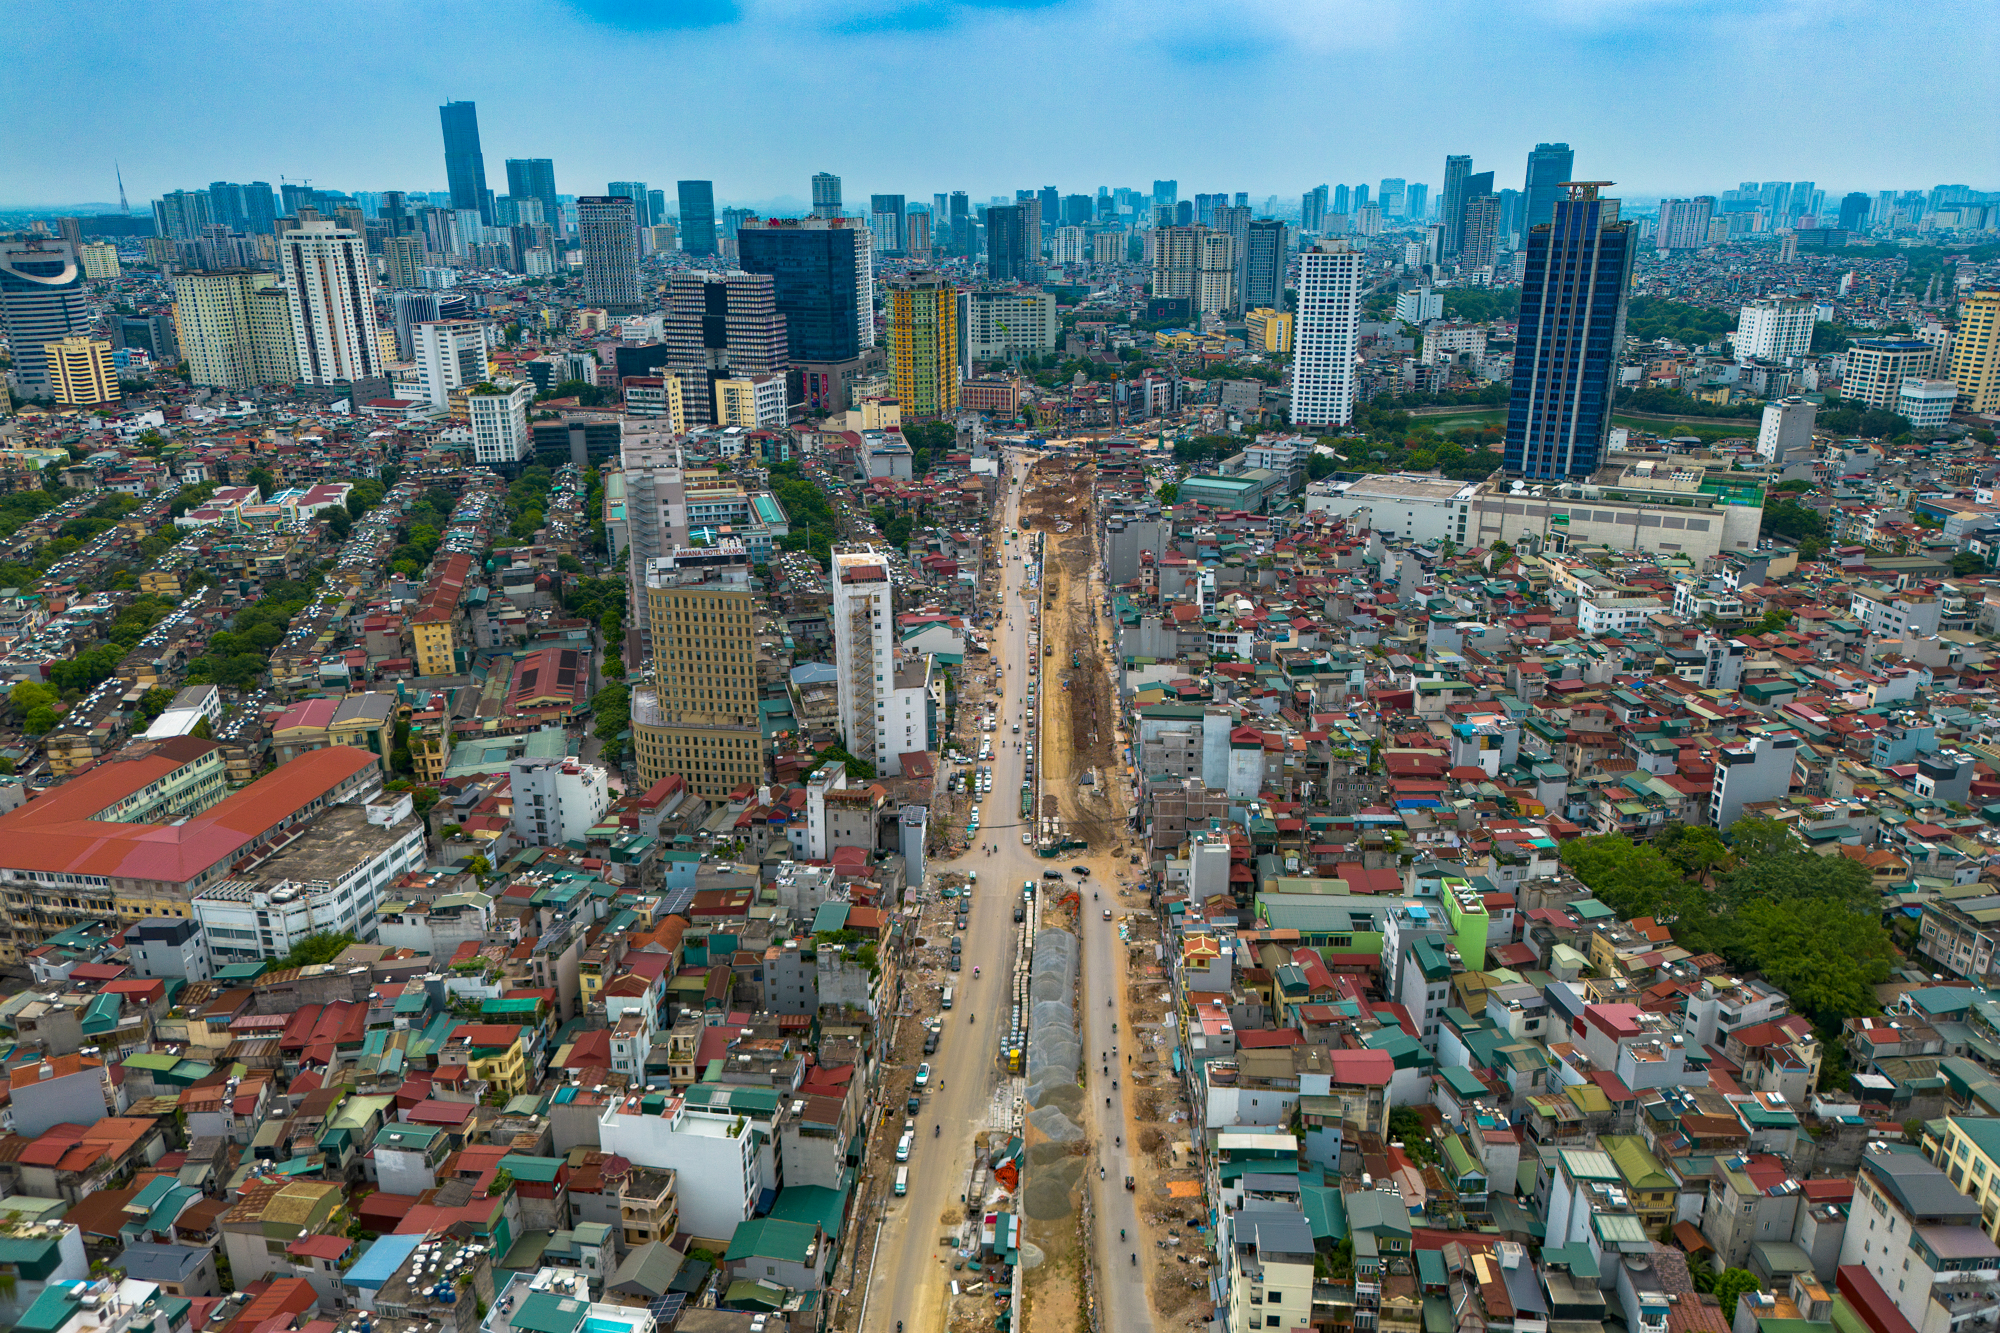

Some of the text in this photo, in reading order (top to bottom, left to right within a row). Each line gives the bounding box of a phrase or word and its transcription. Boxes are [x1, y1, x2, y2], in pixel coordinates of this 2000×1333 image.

[781, 218, 798, 226] MSB
[675, 549, 702, 557] AMIANA
[723, 547, 744, 555] HANOI
